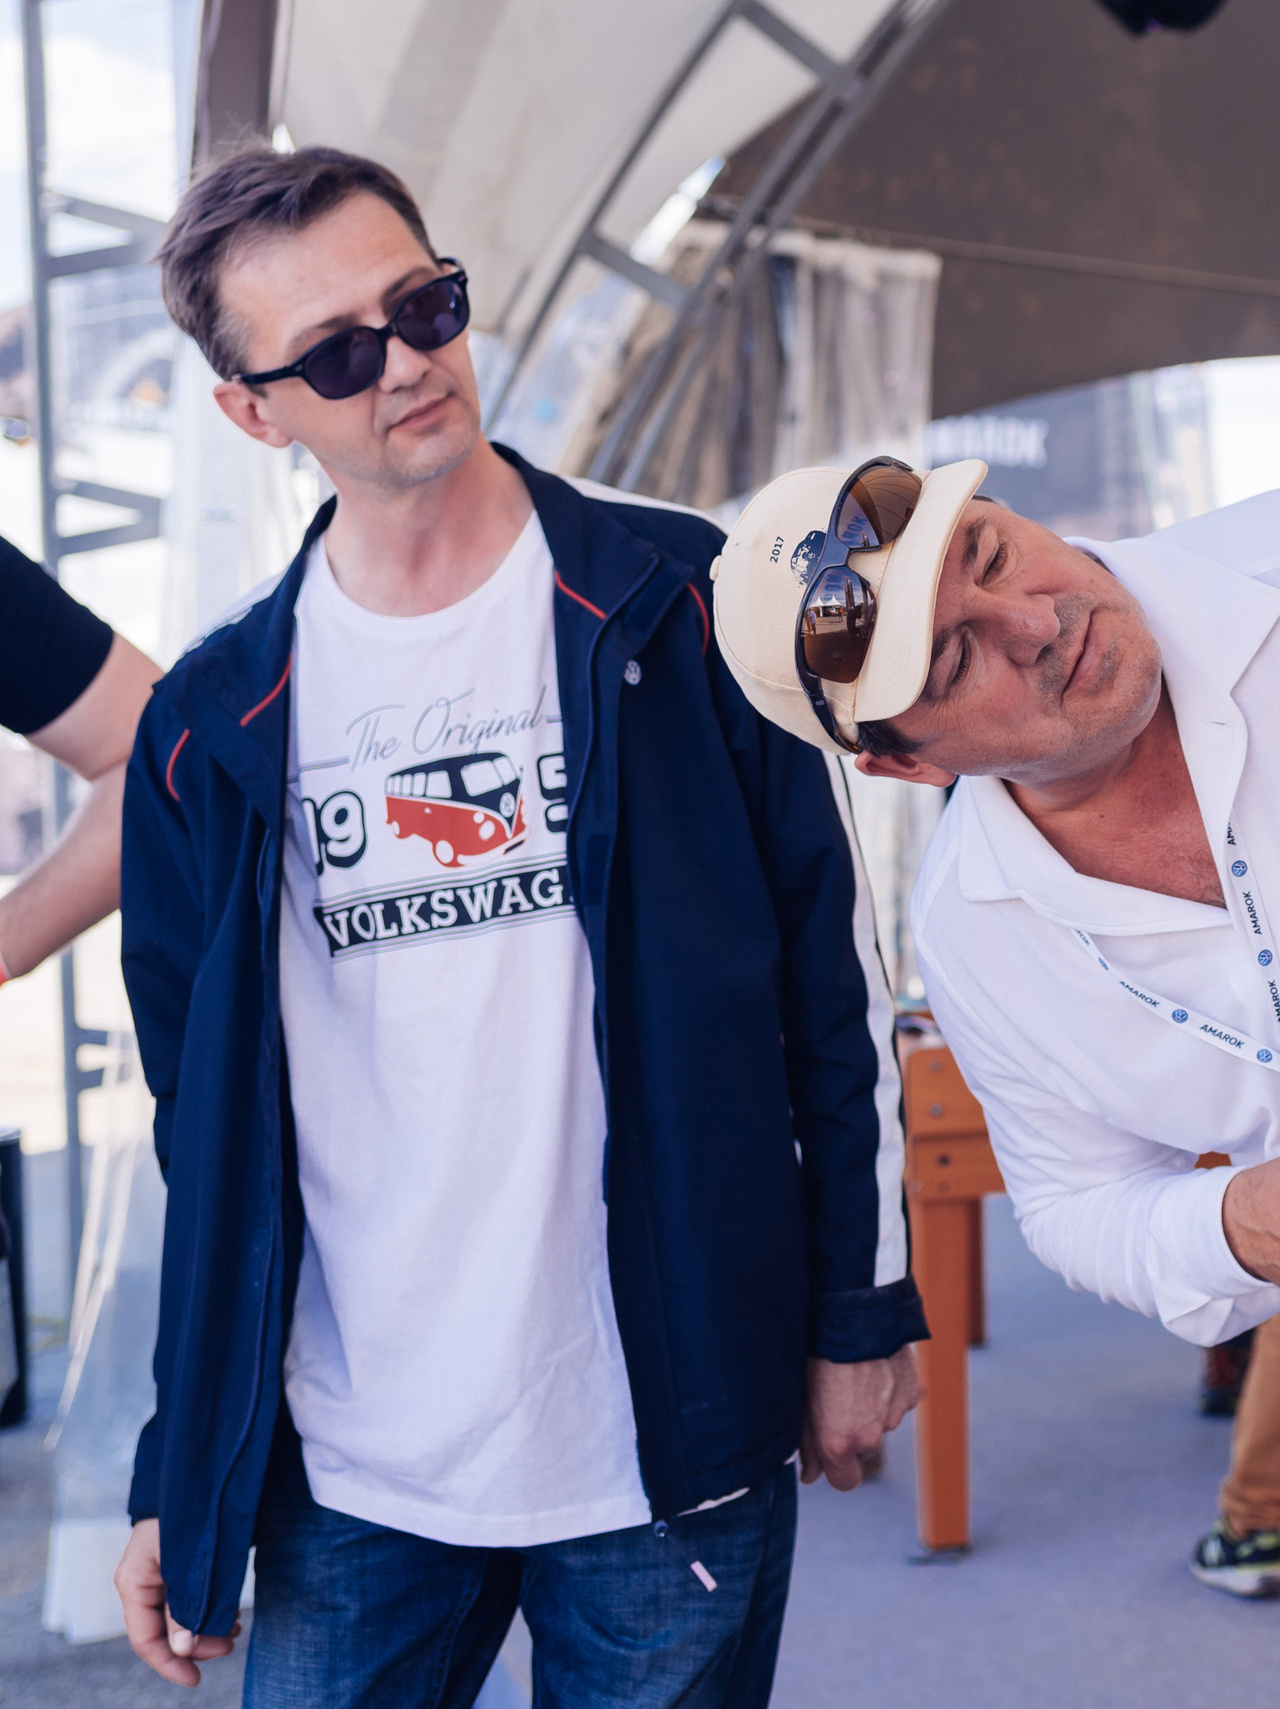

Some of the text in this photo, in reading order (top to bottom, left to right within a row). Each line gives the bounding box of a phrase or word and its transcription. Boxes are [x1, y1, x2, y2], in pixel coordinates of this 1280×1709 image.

[924, 414, 1049, 469] MAROK
[769, 535, 785, 564] 2017
[346, 684, 549, 774] The Original
[1242, 890, 1263, 935] AMAROK
[1118, 980, 1161, 1008] AMAROK
[1199, 1023, 1246, 1049] AMAROK
